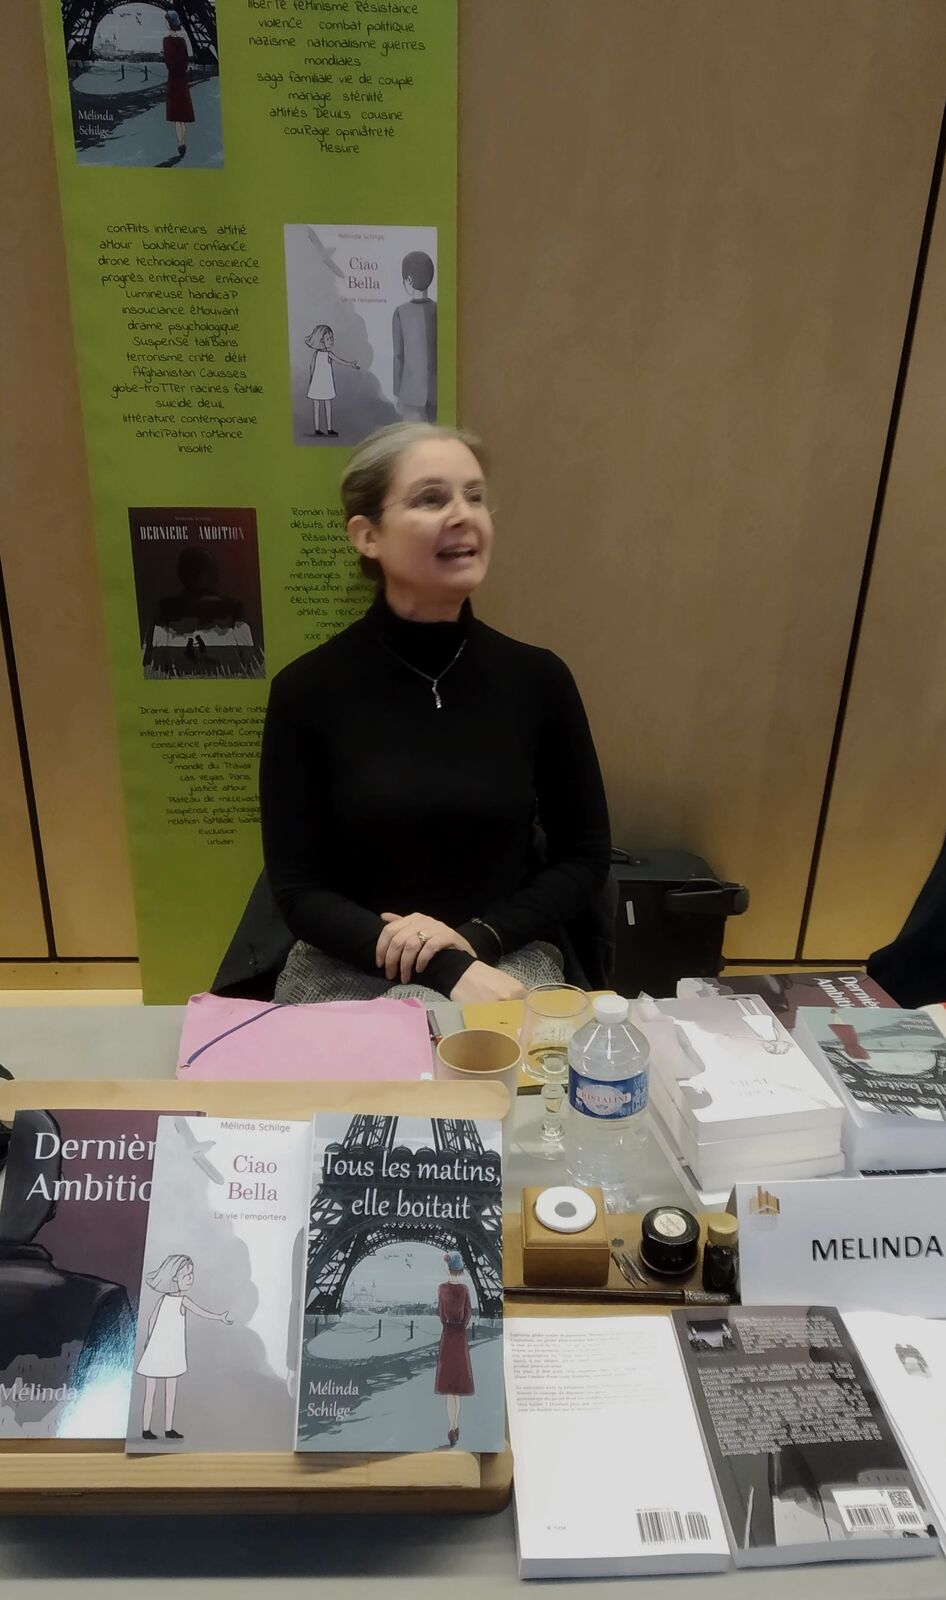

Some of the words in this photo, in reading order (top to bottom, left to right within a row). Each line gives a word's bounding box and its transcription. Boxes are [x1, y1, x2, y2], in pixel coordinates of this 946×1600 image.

[319, 19, 362, 31] combat
[249, 36, 296, 47] nazisme
[307, 37, 376, 49] nationalisme
[380, 40, 426, 57] guerres
[304, 54, 361, 66] mondiales
[257, 72, 284, 89] saga
[289, 71, 334, 84] familiale
[339, 75, 353, 84] vie
[359, 73, 373, 84] de
[378, 75, 414, 90] couple
[288, 92, 331, 108] mariage
[78, 109, 114, 121] Mélinda
[361, 110, 403, 121] cousine
[79, 124, 110, 138] Schilge
[336, 125, 395, 140] opiniâtreté
[320, 142, 360, 153] Mesure
[154, 223, 208, 235] intérieurs
[98, 255, 131, 266] drone
[136, 256, 193, 274] technologie
[349, 257, 378, 271] Ciao
[101, 273, 144, 289] progrès
[149, 273, 205, 287] entreprise
[215, 273, 260, 285] enfance
[348, 276, 380, 290] Bella
[122, 305, 184, 315] insouciance
[127, 319, 163, 331] drame
[168, 320, 240, 337] psychologique
[127, 352, 183, 362] terrorisme
[225, 352, 247, 363] délit
[133, 366, 196, 383] Afghanistan
[200, 367, 247, 378] Causses
[190, 383, 229, 394] racines
[155, 399, 193, 409] suicide
[123, 414, 175, 424] littérature
[180, 414, 258, 427] contemporaine
[177, 444, 213, 454] insolite
[291, 507, 323, 516] Roman
[199, 526, 245, 541] AMBITION
[290, 572, 341, 585] mensonges
[864, 1078, 924, 1095] boitait
[220, 1121, 255, 1131] Mélinda
[258, 1123, 291, 1133] Schilge
[34, 1132, 158, 1161] Dernièr
[233, 1154, 278, 1174] Ciao
[324, 1151, 374, 1176] Tous
[382, 1150, 410, 1178] les
[417, 1158, 501, 1186] matins,
[227, 1182, 278, 1201] Bella
[351, 1187, 390, 1216] elle
[396, 1189, 471, 1220] boitait
[226, 1212, 238, 1220] vie
[240, 1212, 287, 1222] l'emportera
[812, 1235, 944, 1262] MELINDA
[0, 1383, 77, 1402] Mélinda
[309, 1378, 359, 1396] Mélinda
[307, 1400, 351, 1422] Schilge
